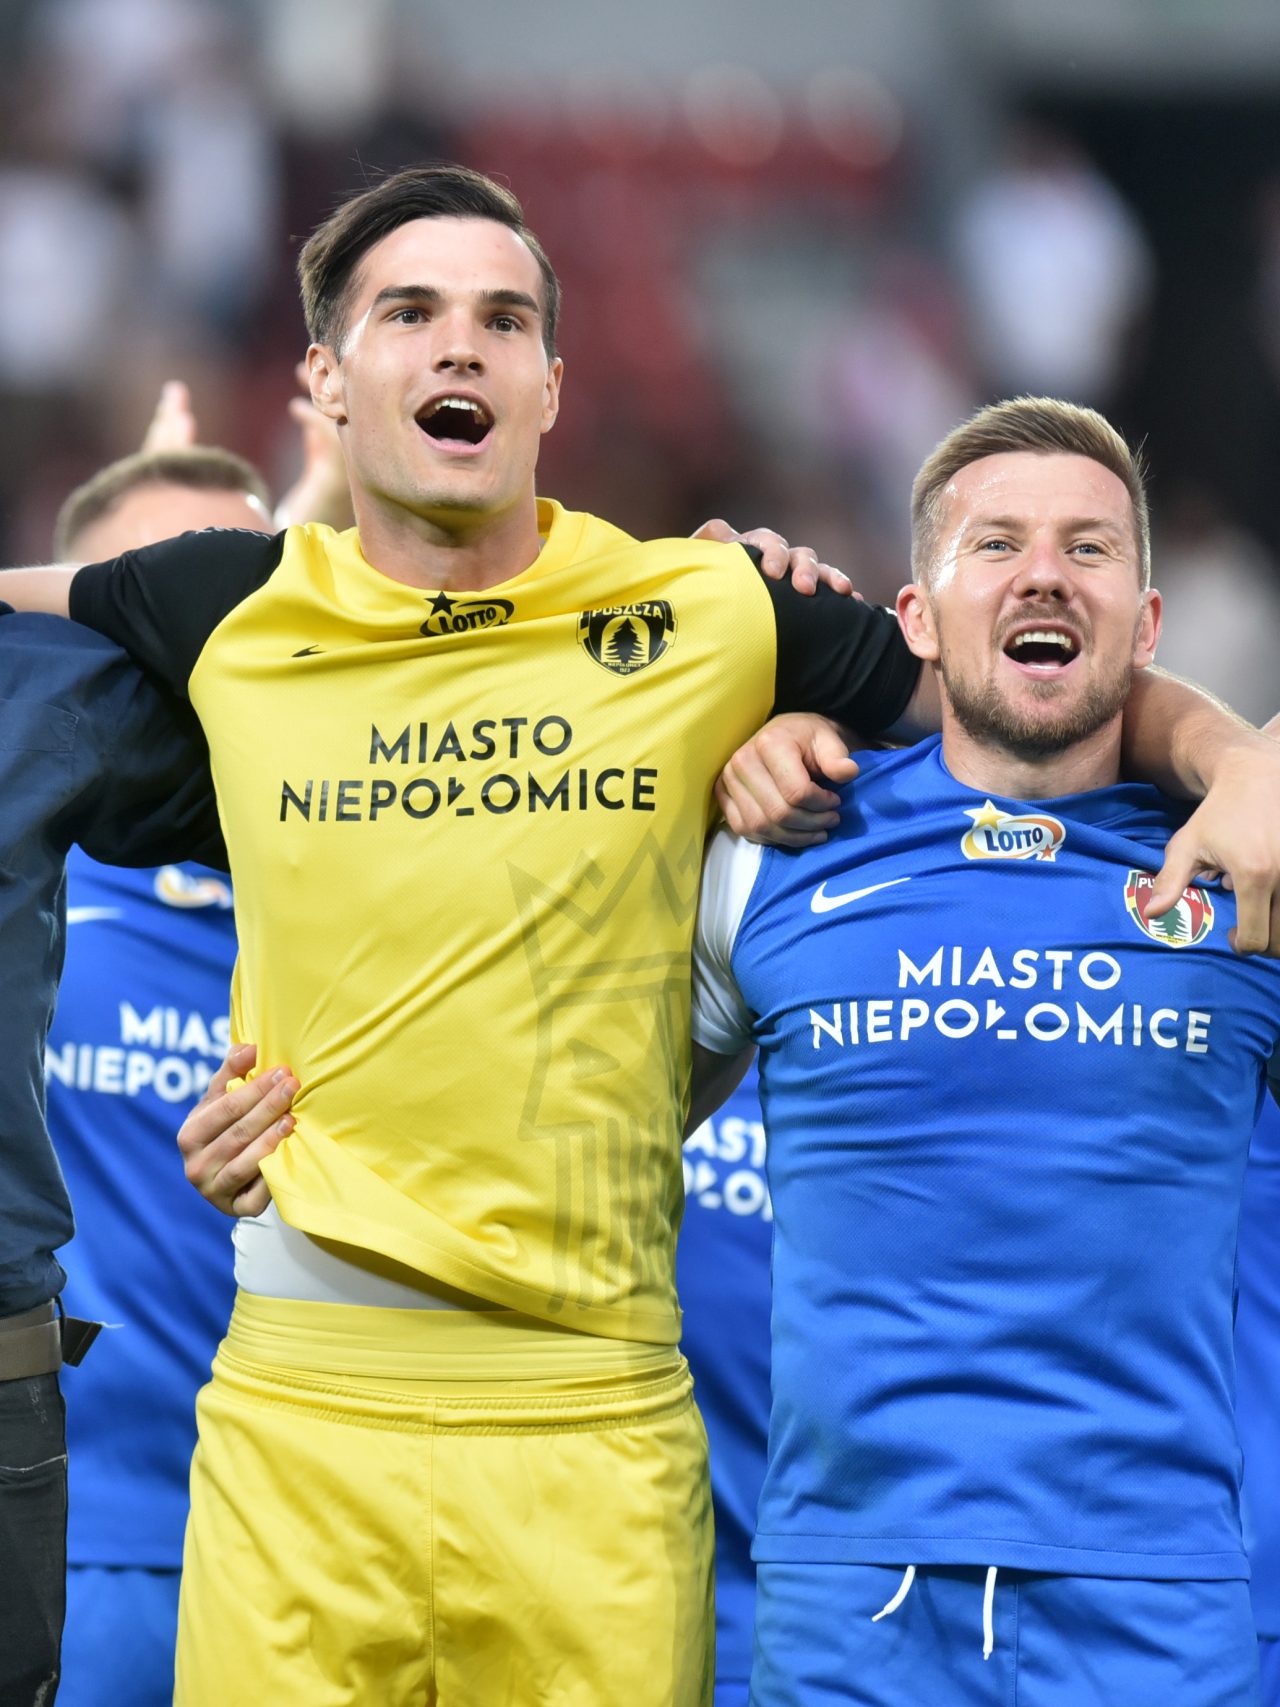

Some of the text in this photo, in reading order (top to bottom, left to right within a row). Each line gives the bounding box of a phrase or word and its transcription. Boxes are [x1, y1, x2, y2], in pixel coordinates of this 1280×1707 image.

[438, 607, 497, 633] LOTTO
[369, 715, 572, 764] MIASTO
[279, 768, 658, 822] NIEPOŁOMICE
[984, 827, 1044, 852] LOTTO
[898, 945, 1121, 990] MIASTO
[121, 1002, 231, 1059] MIAS
[808, 998, 1212, 1053] NIEPOŁOMICE
